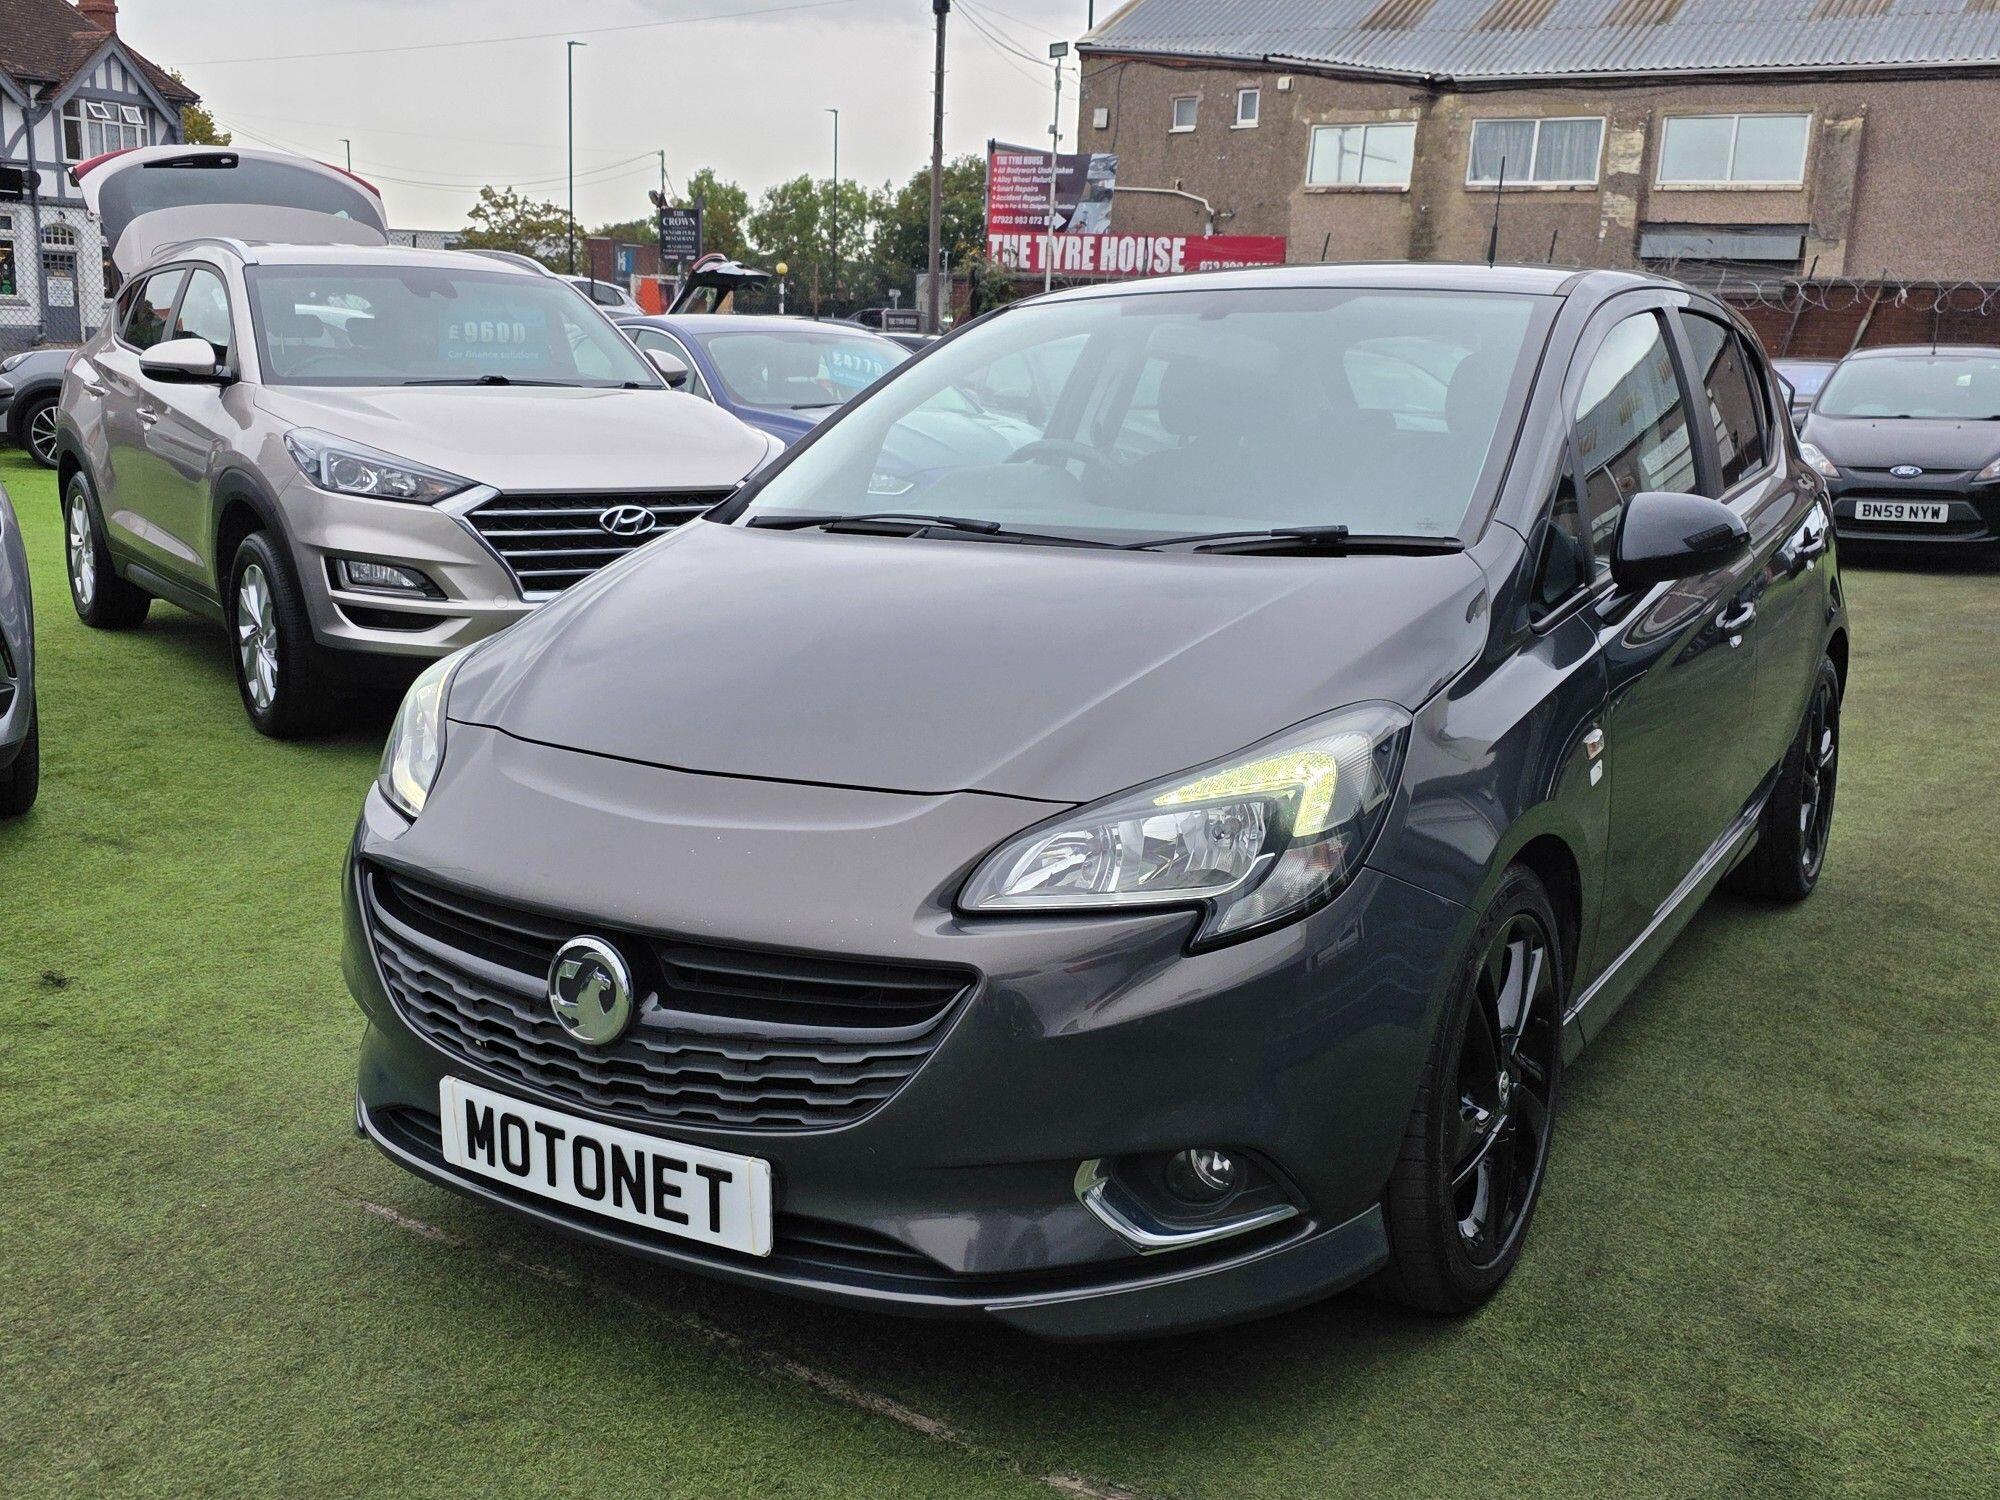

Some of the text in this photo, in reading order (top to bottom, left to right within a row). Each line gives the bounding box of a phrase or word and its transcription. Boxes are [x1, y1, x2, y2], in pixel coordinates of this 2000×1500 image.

[1023, 156, 1043, 165] HOUSE
[662, 217, 696, 226] CROWN
[988, 234, 1187, 273] THE TYRE HOUSE
[1862, 504, 1941, 519] BN59 NYW
[465, 1098, 733, 1234] MOTONET
